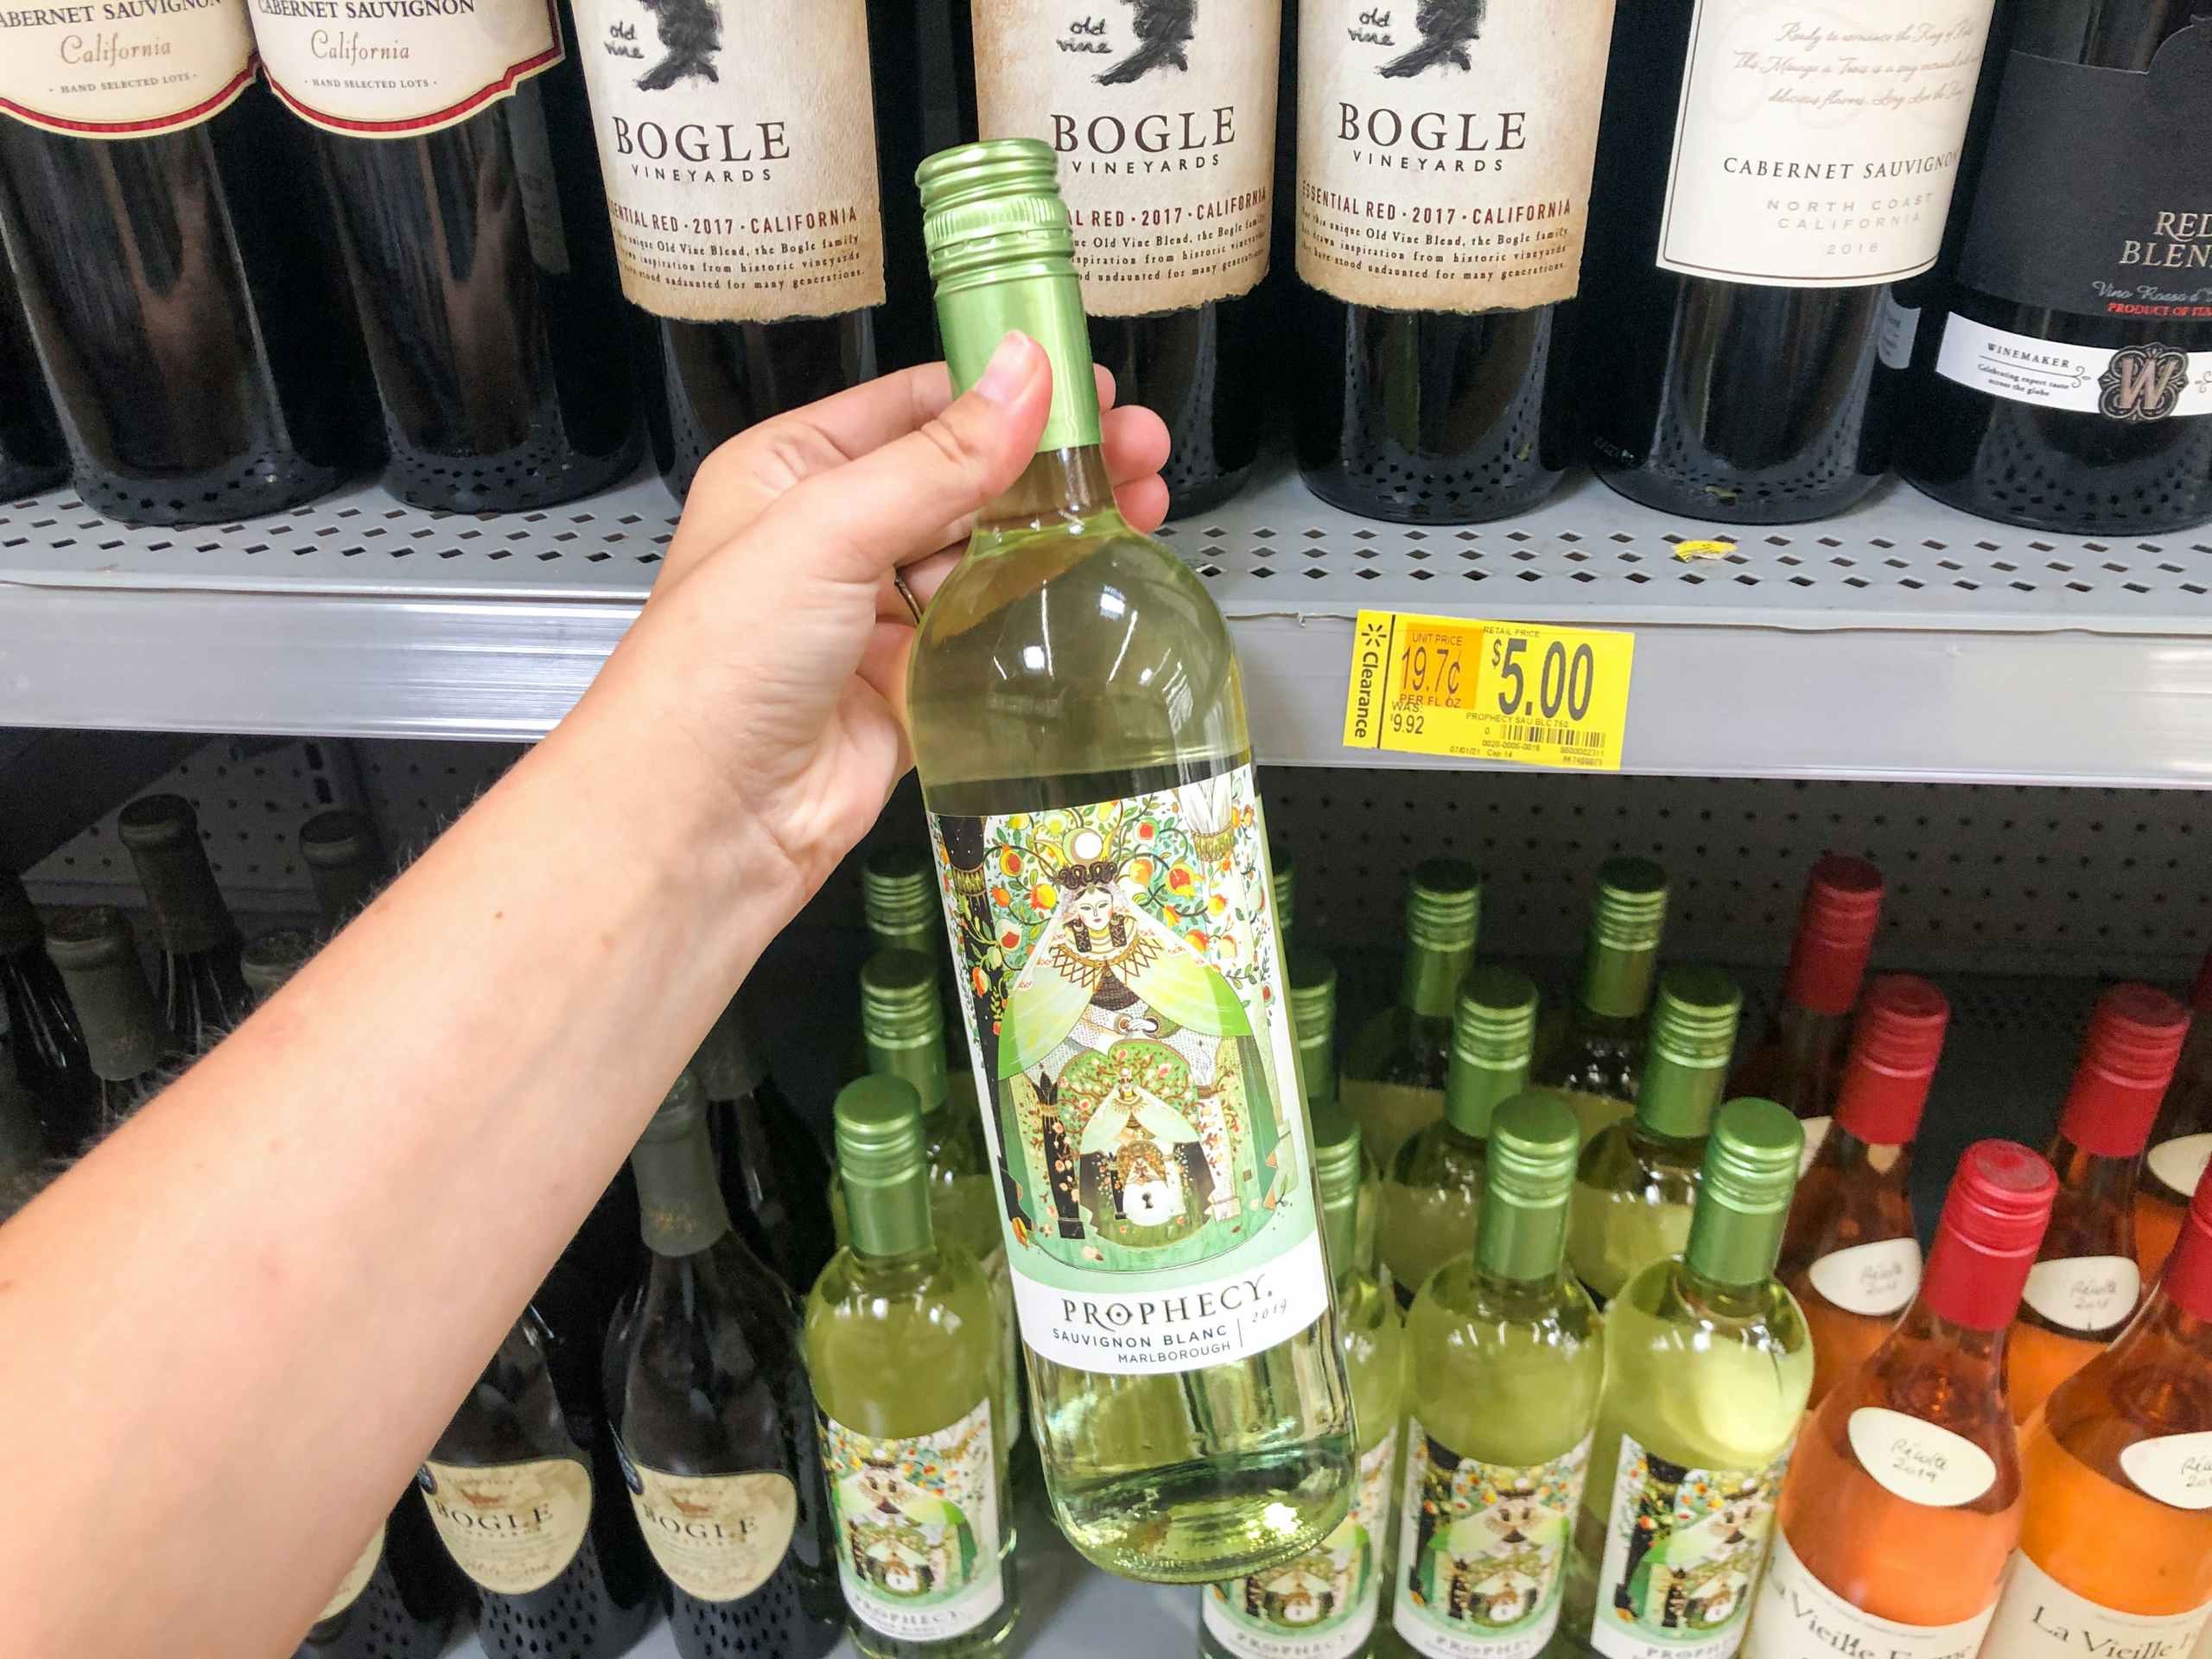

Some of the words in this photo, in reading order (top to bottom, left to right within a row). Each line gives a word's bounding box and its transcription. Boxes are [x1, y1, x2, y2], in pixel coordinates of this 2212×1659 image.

[0, 5, 95, 28] ABERNET
[346, 0, 474, 18] SAUVIGNON
[1359, 8, 1391, 27] old
[610, 20, 637, 41] old
[1071, 16, 1106, 35] old
[311, 29, 410, 66] California
[1056, 39, 1113, 54] vine
[1348, 28, 1395, 46] vine
[60, 32, 172, 67] California
[605, 41, 645, 59] vine
[61, 84, 96, 93] HAND
[101, 78, 159, 91] SELECTED
[163, 73, 190, 84] LOTS
[313, 79, 340, 88] HAND
[345, 79, 397, 89] SELECTED
[401, 78, 429, 88] LOTS
[1051, 105, 1236, 154] BOGLE
[1338, 102, 1526, 151] BOGLE
[612, 117, 790, 162] BOGLE
[1072, 154, 1218, 174] VINEYARDS
[1353, 149, 1503, 172] VINEYARDS
[1723, 156, 1854, 180] CABERNET
[631, 164, 771, 182] VINEYARDS
[1092, 211, 1124, 226] RED
[1141, 207, 1181, 226] 2017
[1197, 187, 1266, 220] CALIFORNIA
[1302, 180, 1358, 214] ESSENTIAL
[1366, 201, 1396, 220] RED
[1412, 207, 1455, 225] 2017
[1472, 199, 1570, 225] CALIFORNIA
[1767, 200, 1856, 213] NORTH
[1872, 193, 1935, 211] COAST
[652, 214, 678, 232] RED
[693, 218, 733, 234] 2017
[751, 207, 857, 234] CALIFORNIA
[1777, 213, 1922, 231] CALIFORNIA
[657, 240, 676, 253] Old
[679, 243, 705, 256] Vine
[710, 245, 749, 257] Blend,
[755, 245, 775, 256] the
[781, 241, 816, 255] Bogle
[823, 233, 859, 249] family
[1093, 237, 1116, 248] Old
[1122, 237, 1149, 247] Vine
[1198, 231, 1213, 241] the
[1218, 223, 1242, 238] Bogle
[1330, 223, 1360, 238] unique
[1366, 228, 1387, 241] Old
[1393, 232, 1419, 245] Vine
[1426, 234, 1465, 247] Blend,
[1472, 235, 1491, 245] the
[1497, 232, 1529, 245] Bogle
[702, 263, 732, 273] from
[741, 261, 794, 272] historic
[802, 251, 860, 268] vineyards
[1145, 253, 1173, 264] from
[1183, 245, 1225, 261] historic
[1340, 241, 1404, 258] inspiration
[1414, 251, 1444, 263] from
[1453, 252, 1506, 263] historic
[1514, 245, 1567, 259] vineyards
[2119, 240, 2212, 269] BLEN
[1098, 270, 1160, 282] undaunted
[1168, 270, 1185, 278] for
[1192, 264, 1217, 276] many
[1335, 257, 1362, 270] stood
[1369, 263, 1427, 278] undaunted
[1435, 269, 1456, 279] for
[1464, 271, 1493, 282] many
[665, 276, 720, 289] undaunted
[728, 278, 746, 289] for
[754, 279, 785, 290] many
[2107, 302, 2170, 315] PRODUCT
[1987, 343, 2070, 368] WINEMAKER
[1412, 632, 1434, 644] UNIT
[1435, 634, 1463, 646] PRICE
[1484, 626, 1512, 636] RETAIL
[1515, 628, 1541, 638] PRICE
[1355, 651, 1378, 739] Clearance
[1400, 694, 1423, 705] PER
[1428, 697, 1440, 707] FL
[1446, 698, 1461, 708] OZ
[1392, 702, 1423, 713] WAS:
[1466, 711, 1513, 723] PROPHECY
[1515, 716, 1534, 725] SAU
[1053, 1327, 1152, 1348] SAUVIGNON
[1163, 1325, 1227, 1346] BLANC
[1118, 1341, 1231, 1364] MARLBOROUGH
[2033, 1606, 2069, 1642] La
